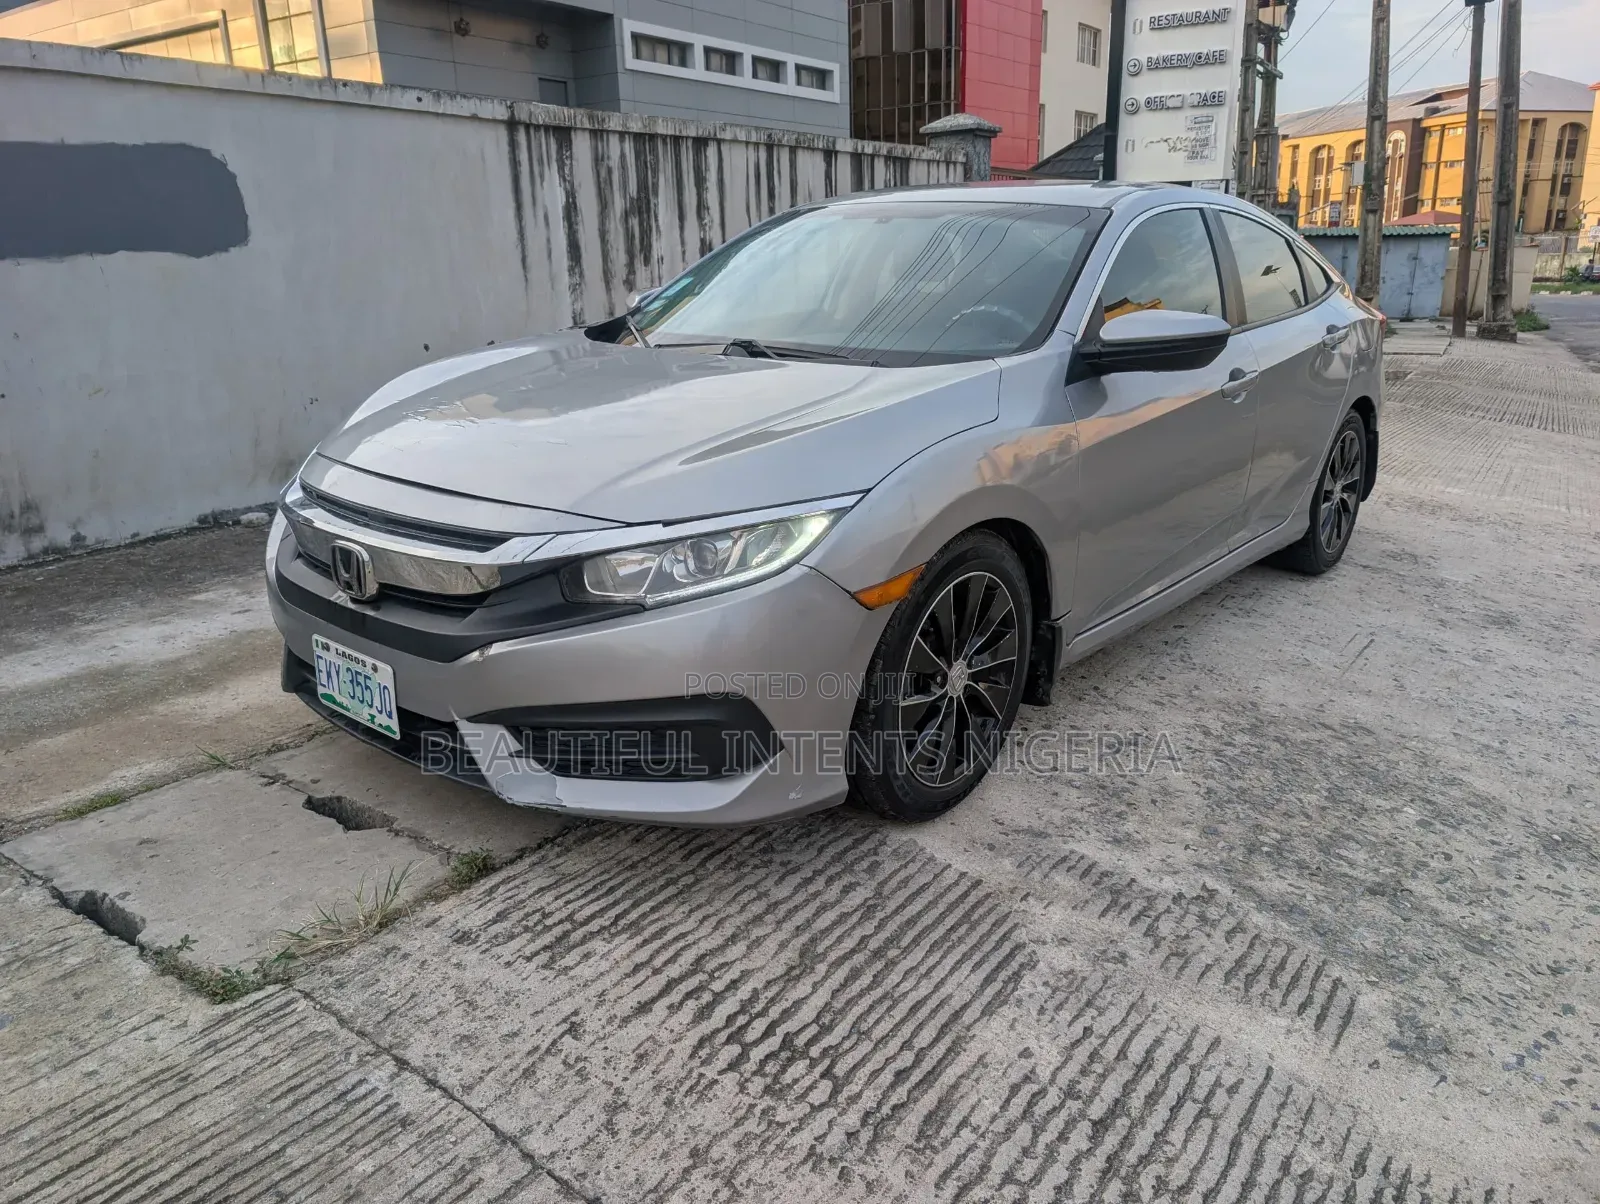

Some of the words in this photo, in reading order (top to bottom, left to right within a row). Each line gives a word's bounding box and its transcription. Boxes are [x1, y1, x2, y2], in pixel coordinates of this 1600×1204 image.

[1148, 7, 1231, 30] RESTAURANT
[1146, 49, 1227, 70] BAKERY/CAFE
[1144, 93, 1184, 110] OFFI
[335, 647, 367, 668] LAGOS
